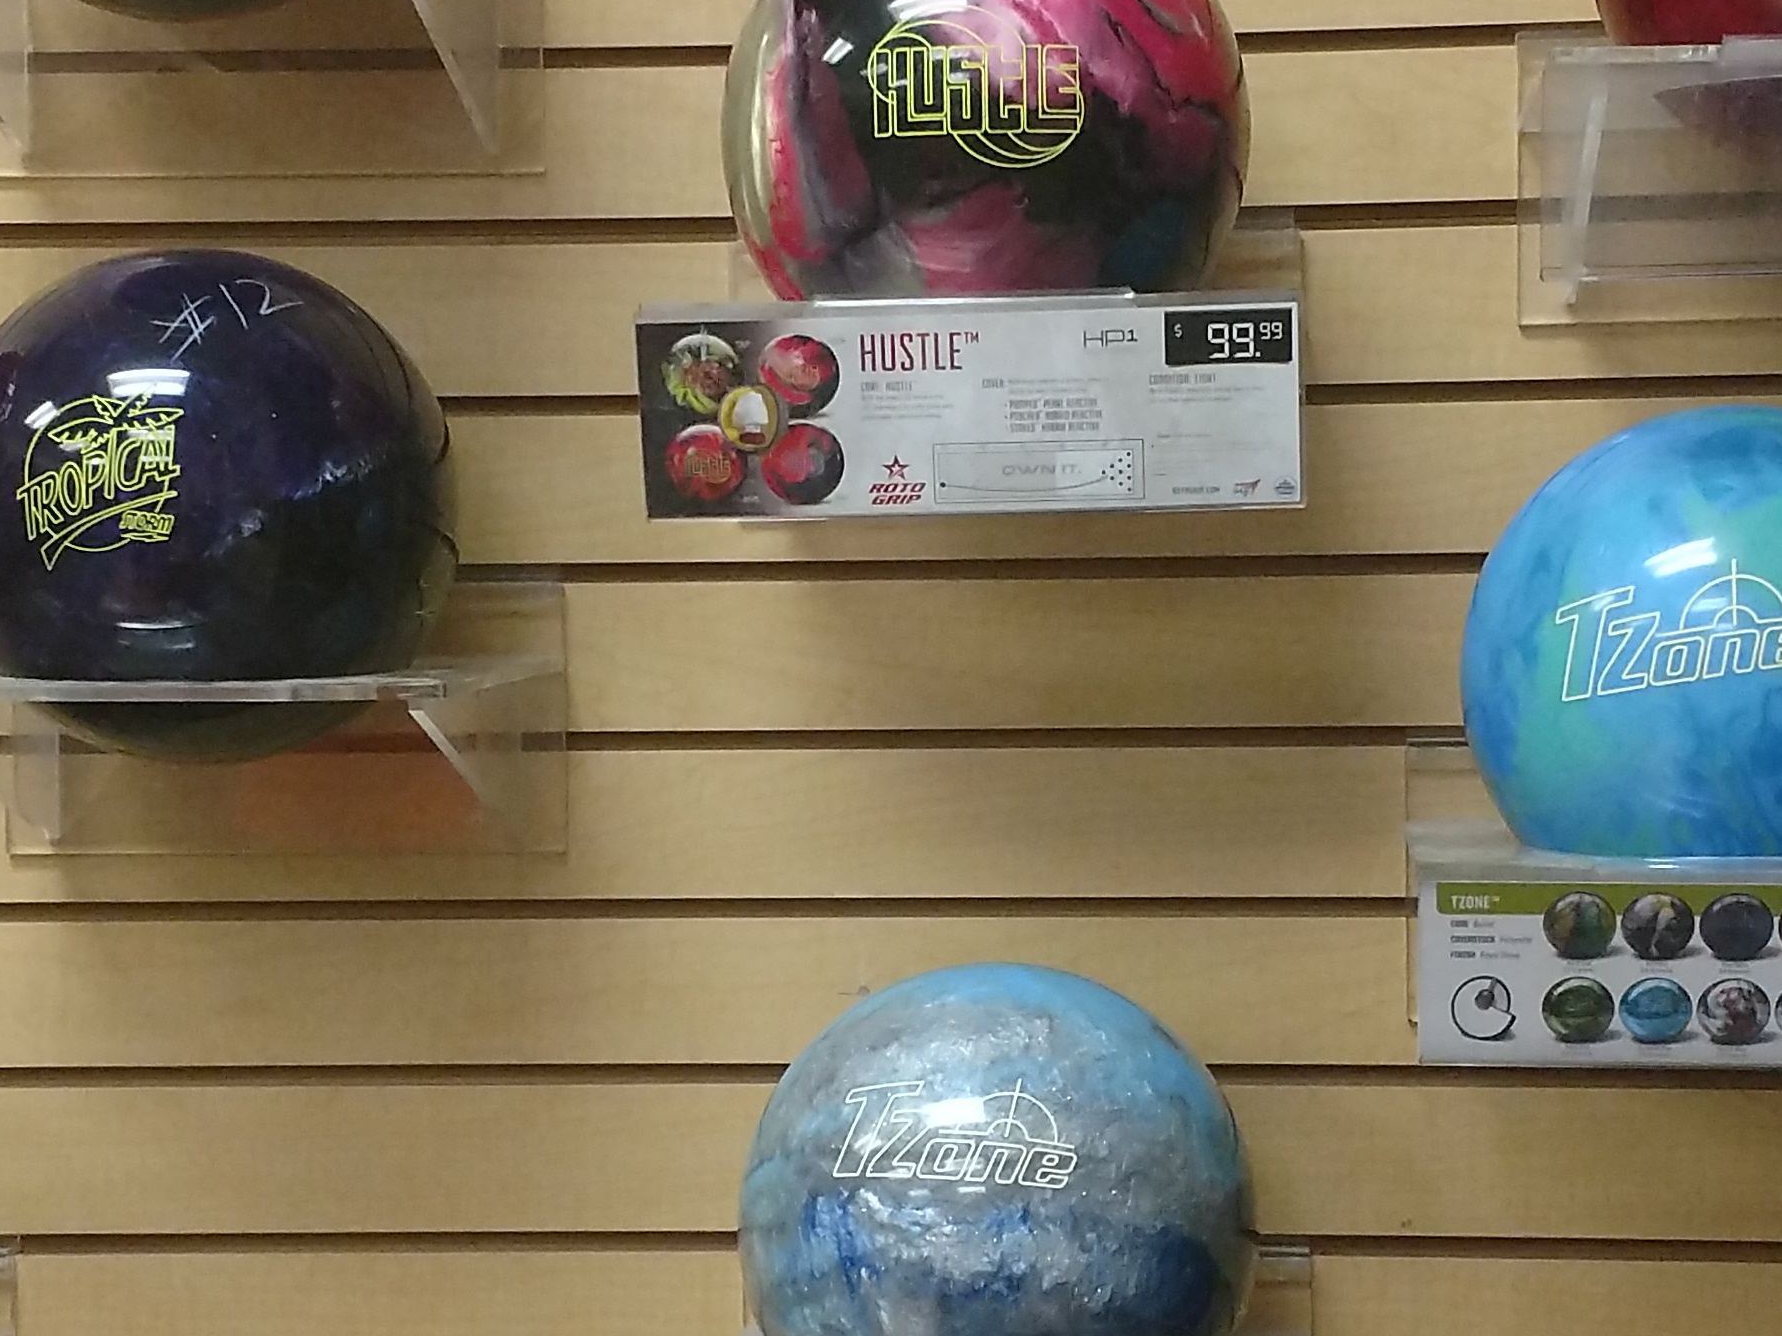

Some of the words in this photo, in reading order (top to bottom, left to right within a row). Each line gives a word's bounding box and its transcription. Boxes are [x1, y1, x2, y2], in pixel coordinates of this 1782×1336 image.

[873, 45, 1079, 138] HUSTLE
[151, 279, 303, 362] #12
[17, 425, 180, 541] TROPICAL
[869, 482, 926, 494] ROTO
[1002, 465, 1056, 475] OWN
[871, 494, 922, 505] GRIP
